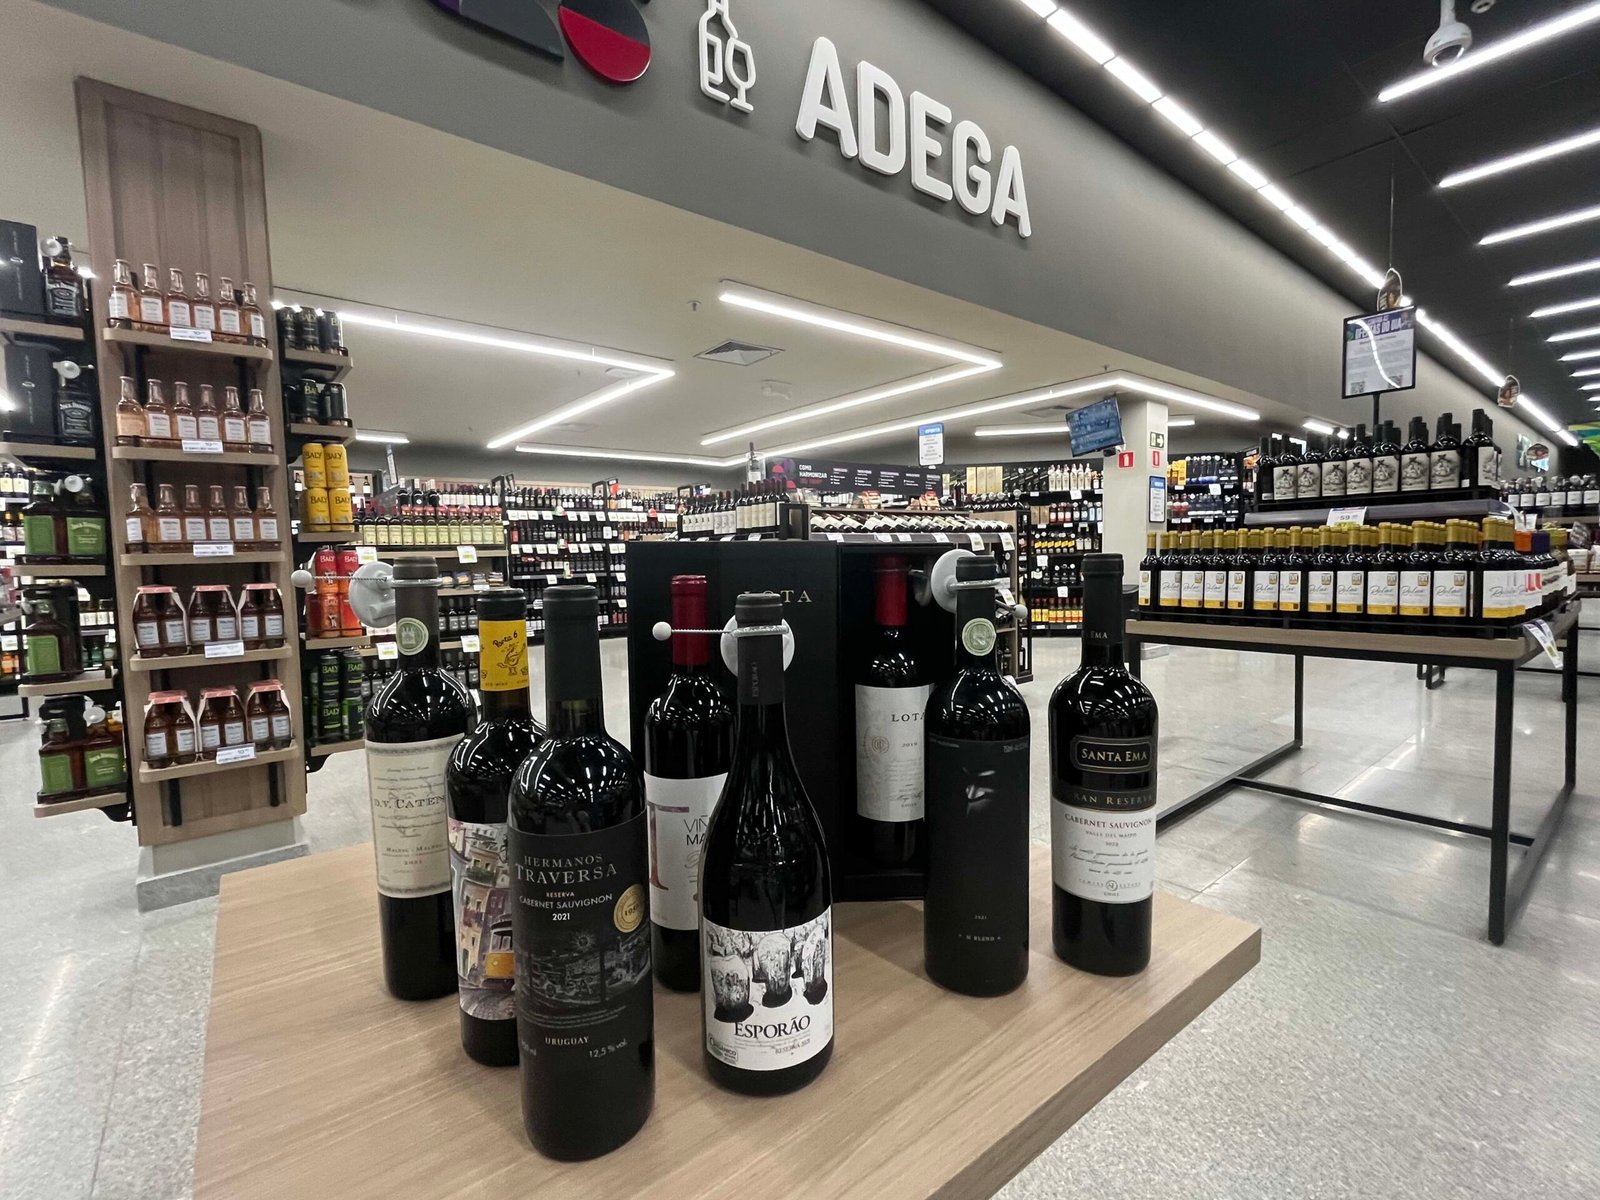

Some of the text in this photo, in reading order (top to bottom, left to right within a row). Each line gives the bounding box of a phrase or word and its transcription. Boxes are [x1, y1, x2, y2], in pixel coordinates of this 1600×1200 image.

[795, 36, 1032, 238] ADEGA
[1355, 321, 1381, 340] OFETAS
[799, 471, 828, 479] HARMONIZAR
[513, 629, 519, 639] 6
[1081, 748, 1148, 762] SANTA EMA
[1072, 792, 1098, 803] RAN
[1064, 813, 1152, 830] CABERNET SAUVIGNON
[524, 853, 603, 868] HERMANOS
[515, 862, 617, 885] TRAVERSA
[519, 893, 613, 909] CABERNET SAUVIGNON
[552, 912, 570, 921] 2021
[734, 1015, 811, 1039] ESPORÃO
[544, 1035, 589, 1046] URUGUAY
